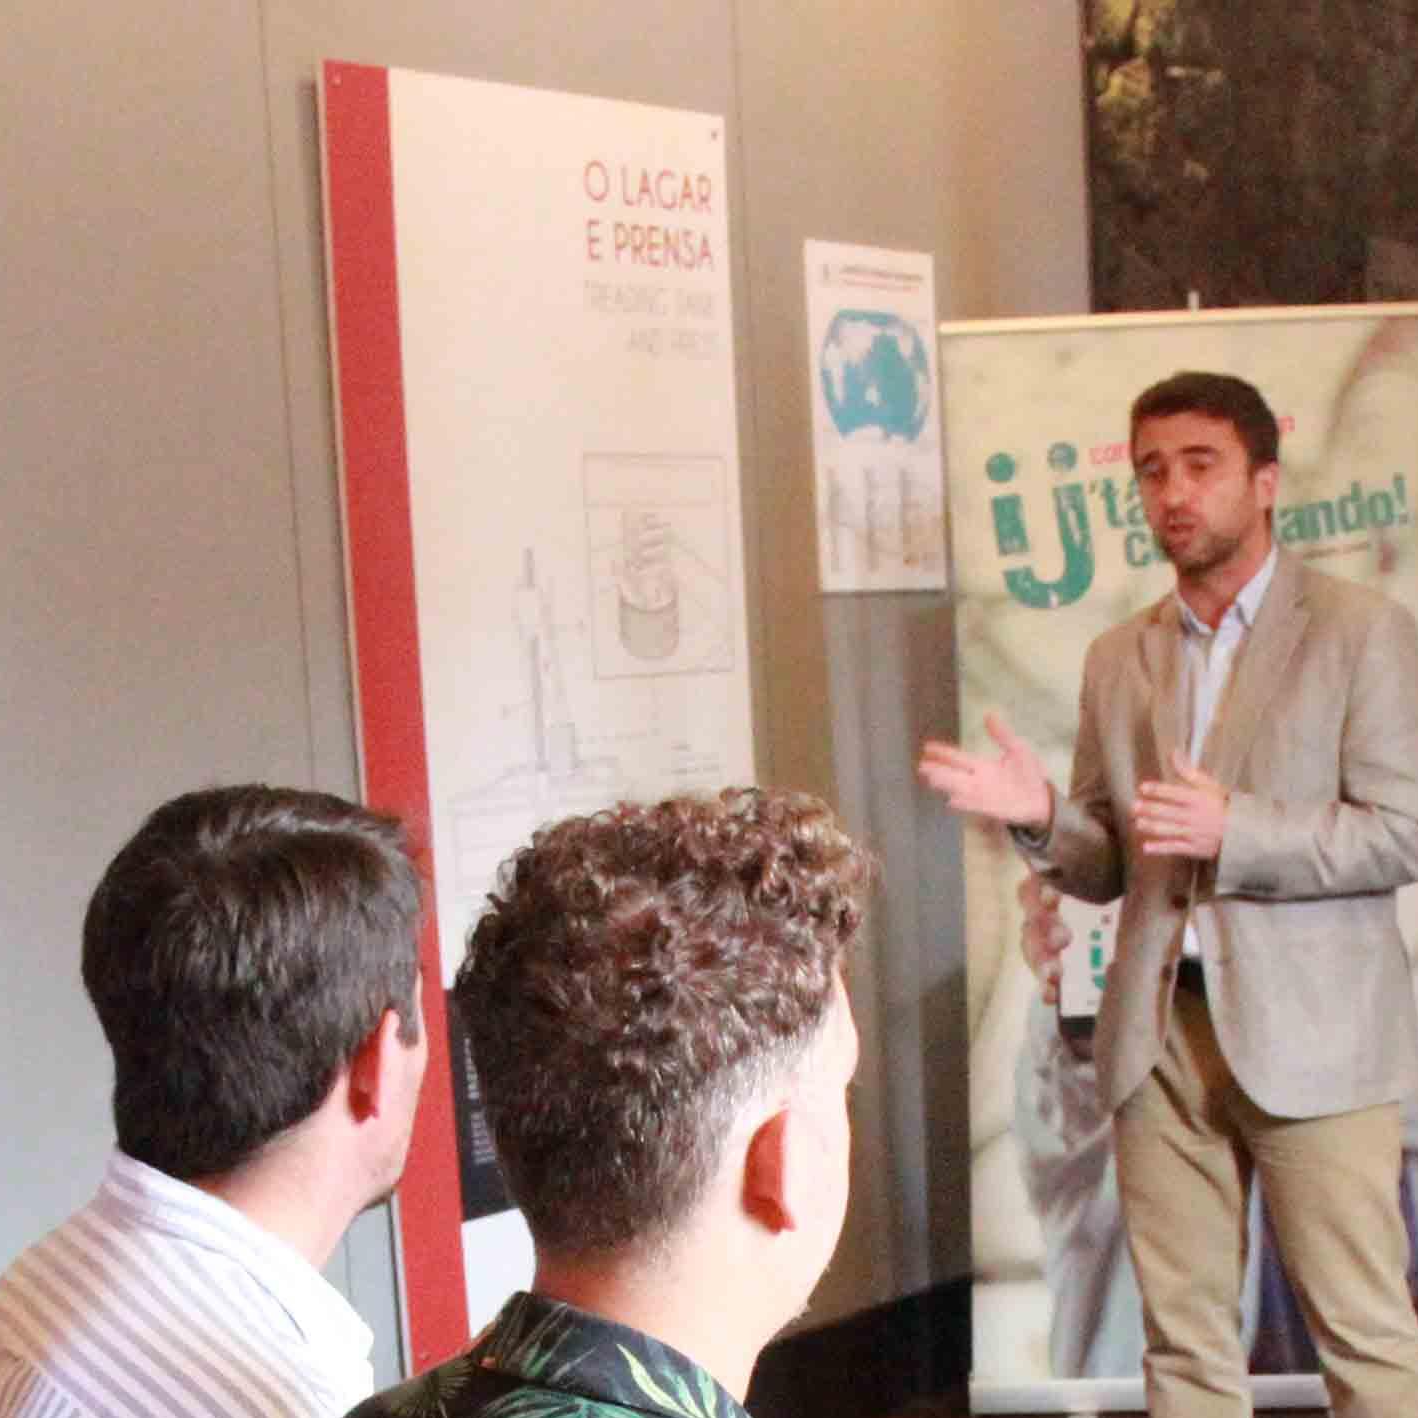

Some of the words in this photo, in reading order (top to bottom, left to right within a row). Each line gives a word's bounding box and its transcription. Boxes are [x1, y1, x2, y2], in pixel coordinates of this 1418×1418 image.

[583, 160, 609, 202] O
[621, 165, 713, 213] LAGAR
[587, 219, 602, 260] E
[614, 221, 714, 272] PRENSA
